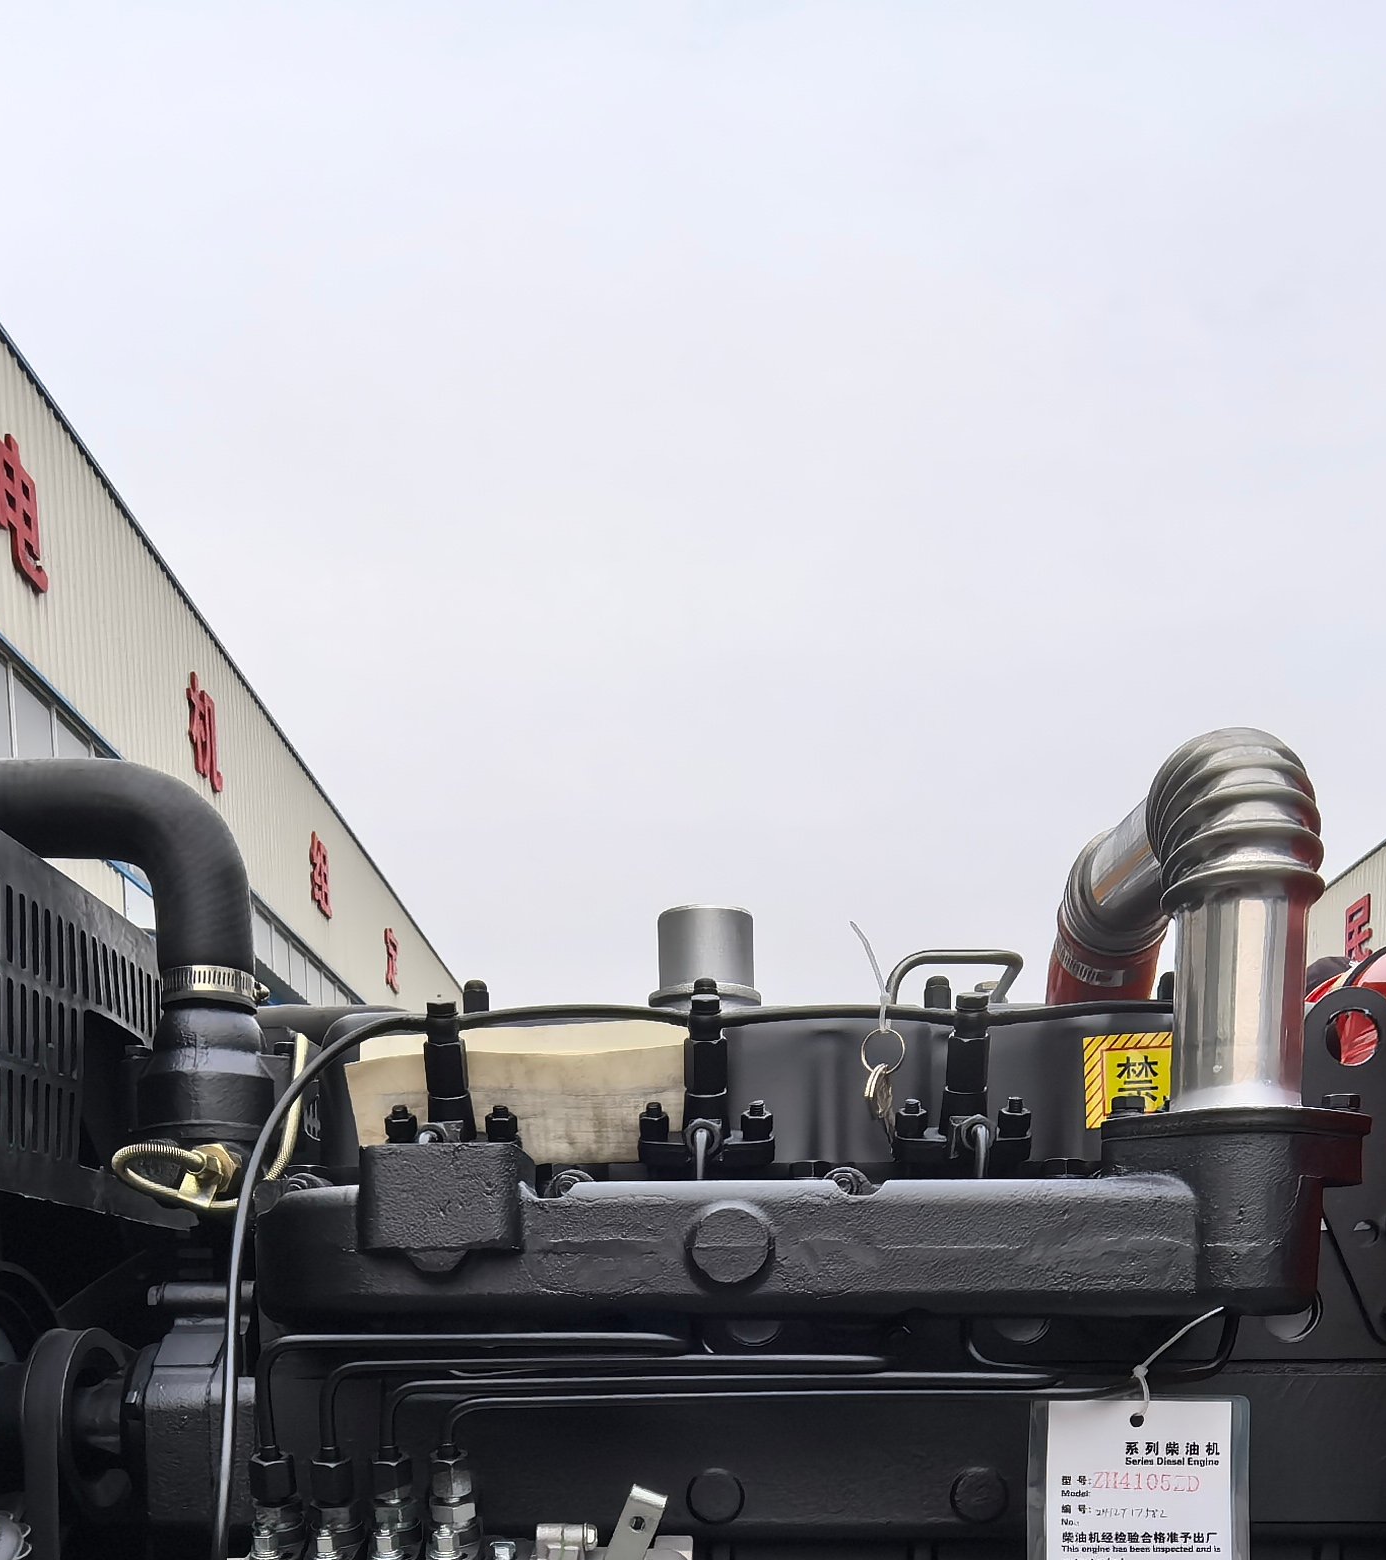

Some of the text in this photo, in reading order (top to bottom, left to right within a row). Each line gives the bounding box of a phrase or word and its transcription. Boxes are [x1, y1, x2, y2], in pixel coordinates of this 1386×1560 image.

[186, 671, 224, 792] 机
[1125, 1441, 1220, 1456] 系列柴油机
[1125, 1457, 1220, 1468] Series Diesel Engine
[1062, 1532, 1217, 1544] 柴油机经检验合格准予出厂
[1062, 1545, 1221, 1555] This engine has been inspected and is
